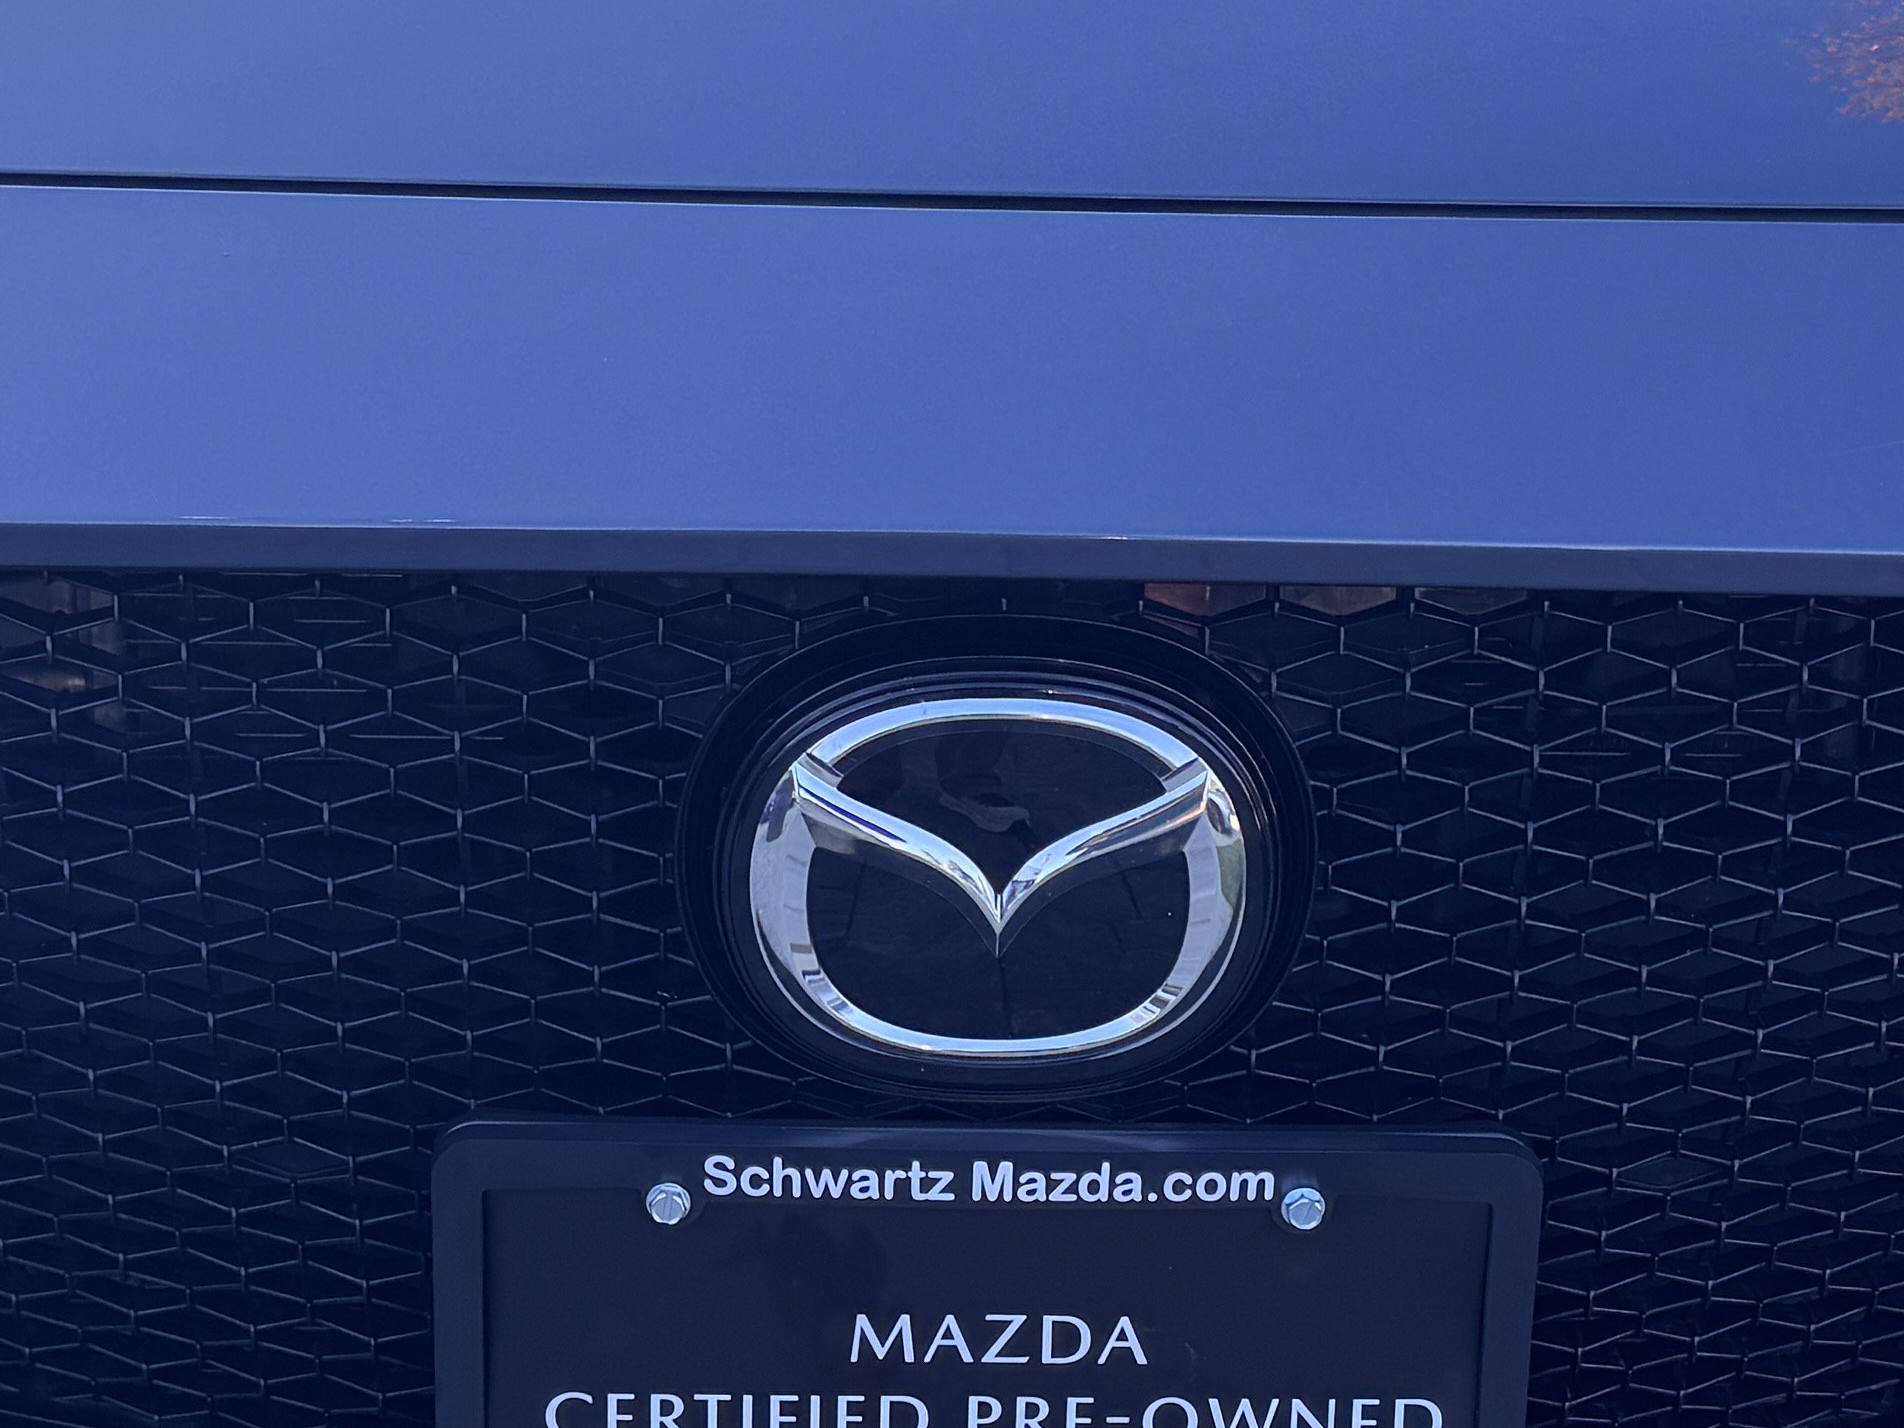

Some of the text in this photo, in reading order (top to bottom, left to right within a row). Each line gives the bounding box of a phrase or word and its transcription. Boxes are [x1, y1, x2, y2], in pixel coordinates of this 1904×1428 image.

[702, 1153, 1276, 1204] Schwartz Mazda.com
[849, 1312, 1149, 1366] MAZDA
